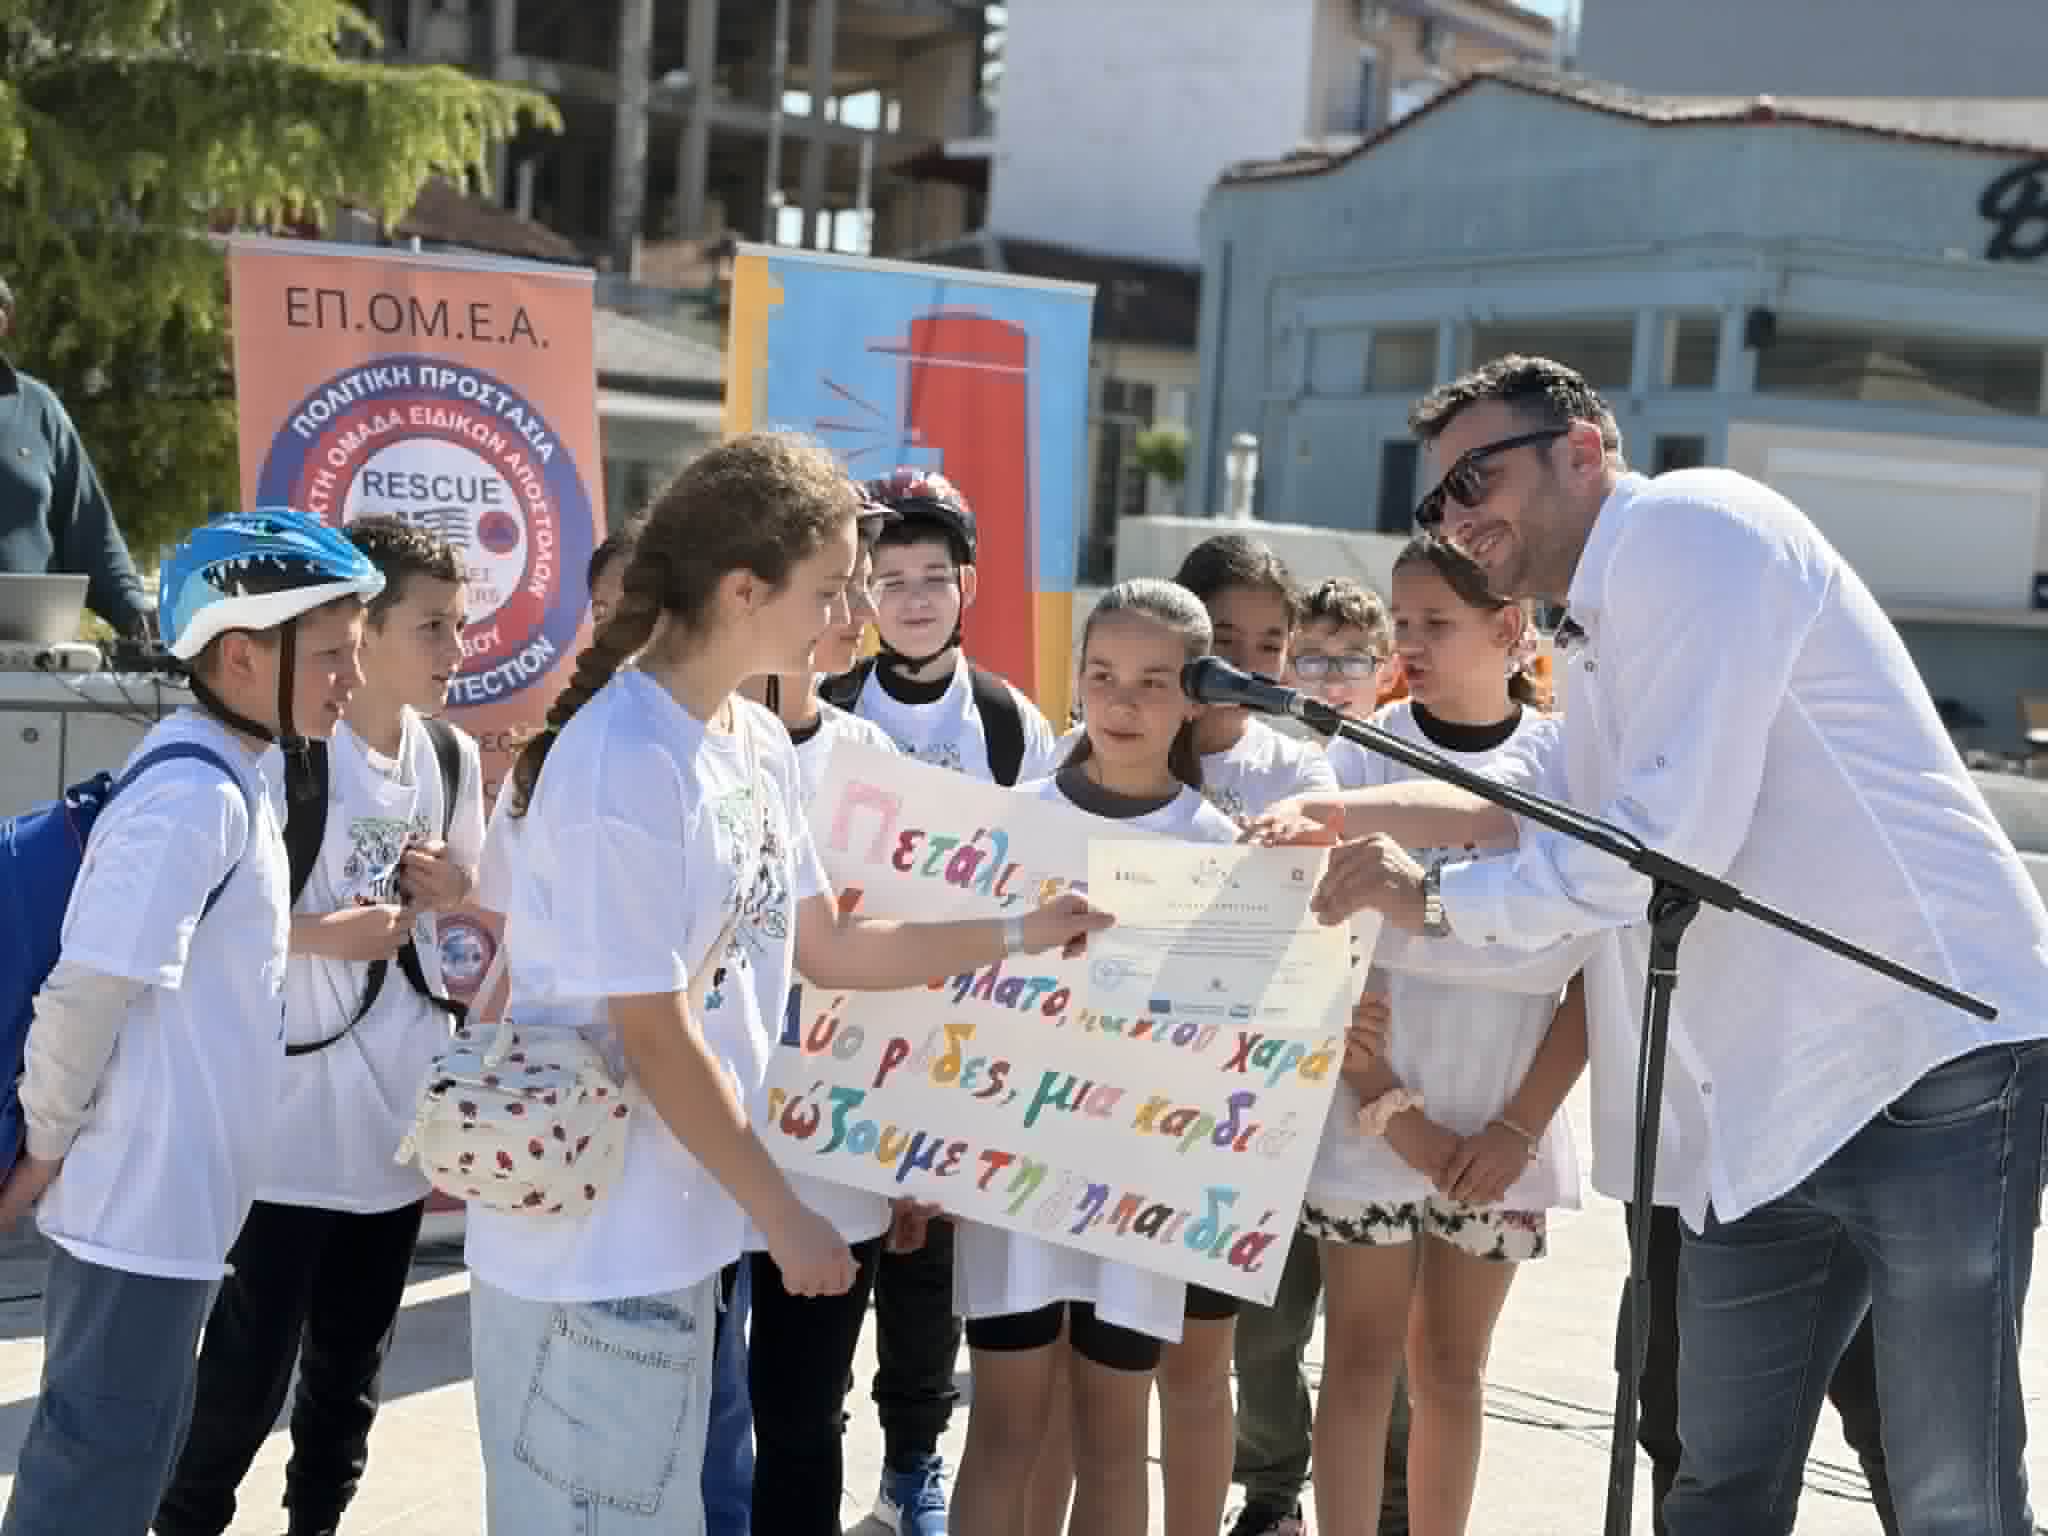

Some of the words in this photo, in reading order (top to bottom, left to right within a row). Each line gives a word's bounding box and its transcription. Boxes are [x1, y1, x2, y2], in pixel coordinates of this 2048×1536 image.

[287, 287, 549, 348] ΕΠ.ΟΜ.Ε.Α.
[291, 366, 412, 438] ΠΟΛΙΤΙΚΗ
[419, 366, 553, 463] ΠΡΟΣΤΑΣΙΑ
[327, 407, 406, 467] ΟΜΑΔΑ
[409, 407, 507, 453] ΕΙΔΙΚΩΝ
[503, 453, 553, 600] ΑΠΟΣΤΟΛΩΝ
[363, 471, 502, 504] RESCUE
[447, 634, 556, 702] TECTION
